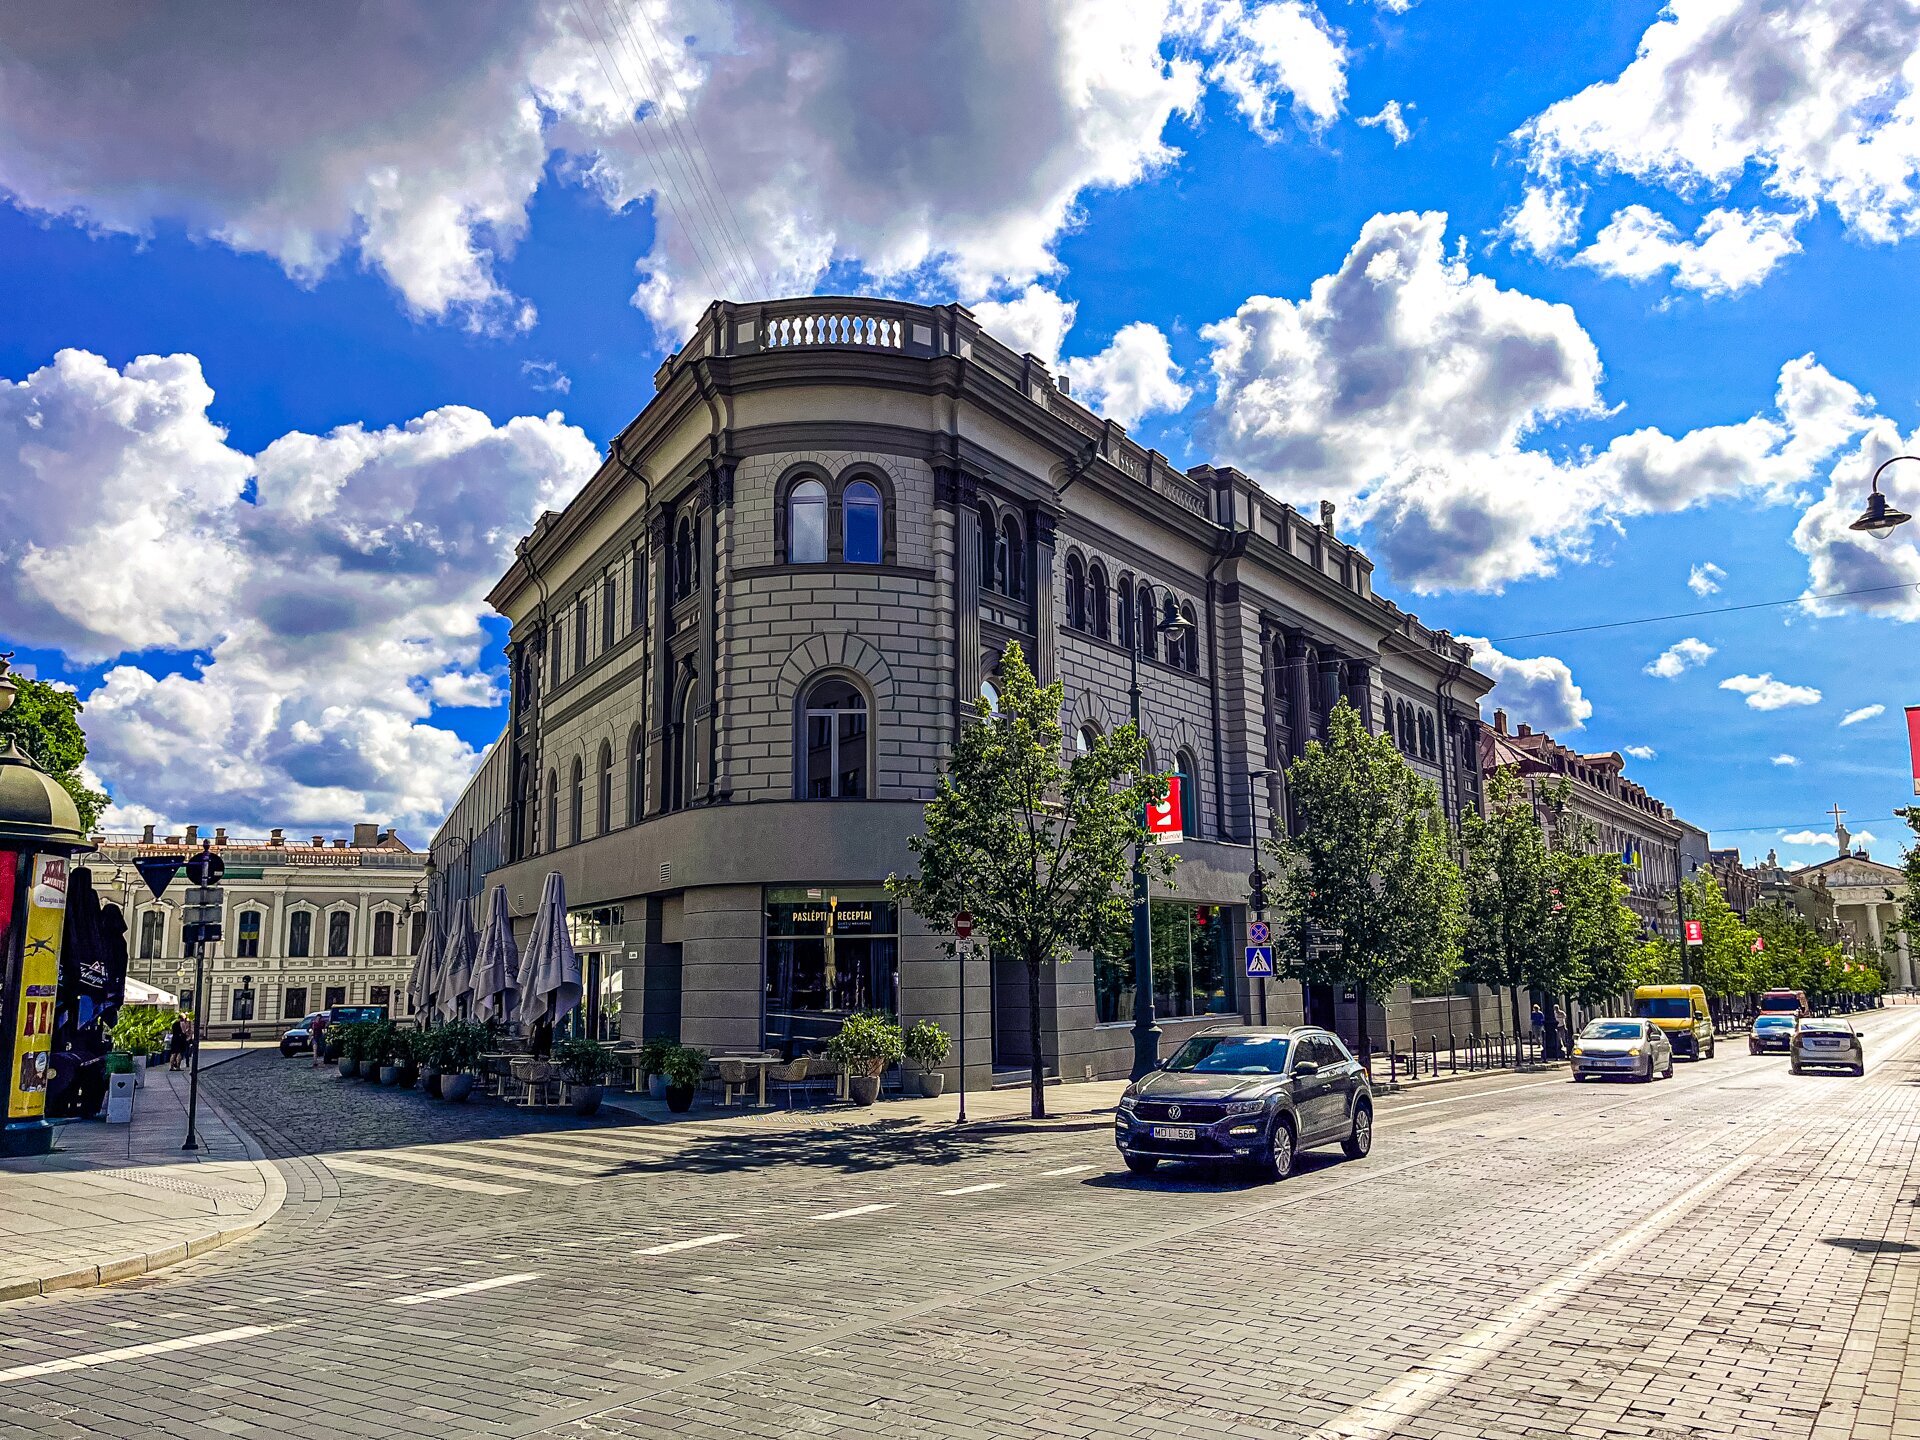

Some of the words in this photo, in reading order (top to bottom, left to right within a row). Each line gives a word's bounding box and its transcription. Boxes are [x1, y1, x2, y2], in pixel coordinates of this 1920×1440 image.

[792, 910, 826, 922] PASLĖPTI
[837, 911, 872, 921] RECEPTAI
[1178, 1129, 1194, 1138] 568
